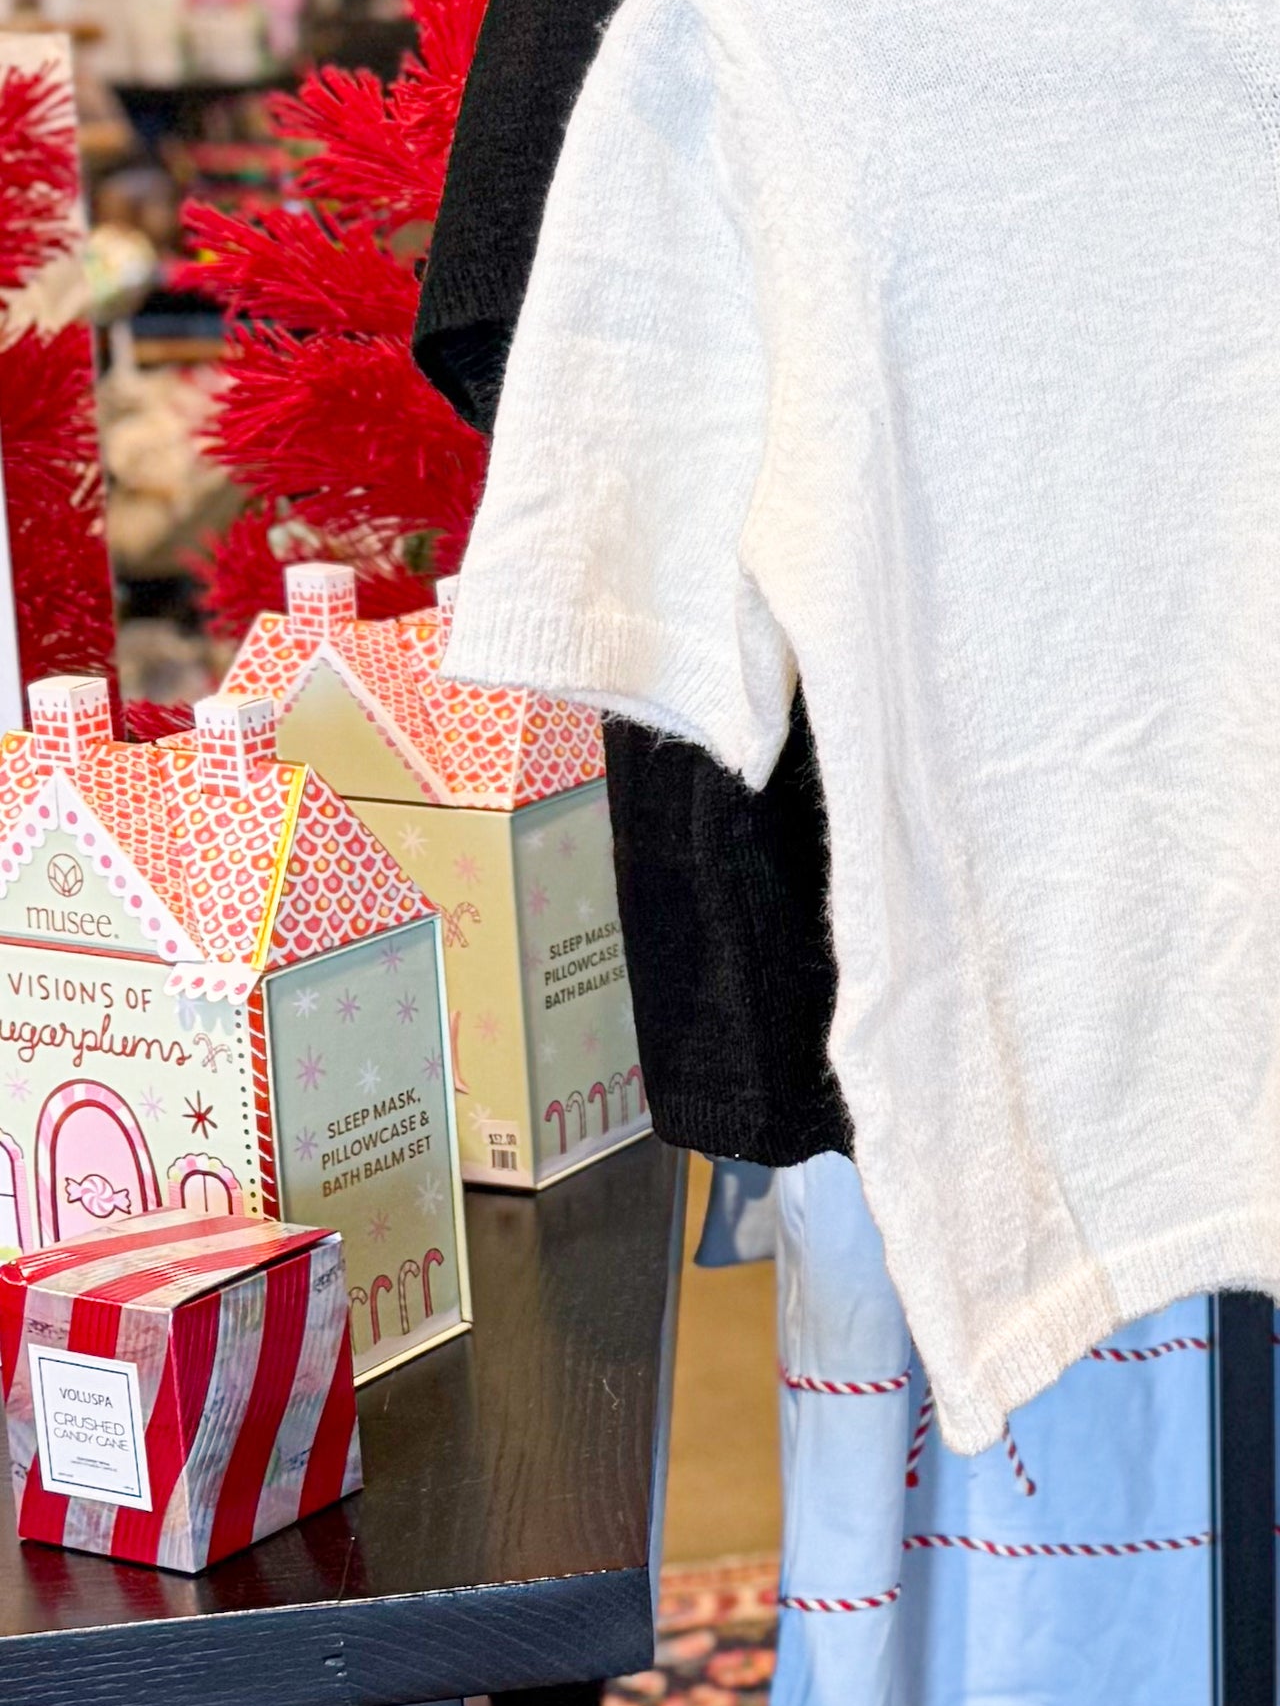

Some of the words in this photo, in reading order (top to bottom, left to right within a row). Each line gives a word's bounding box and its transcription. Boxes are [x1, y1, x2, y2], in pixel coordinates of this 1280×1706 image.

[544, 943, 619, 986] PILLOWCASE
[549, 934, 582, 960] SLEEP
[7, 972, 114, 1008] VISIONS
[125, 987, 152, 1012] OF
[545, 985, 576, 1010] BATH
[578, 971, 610, 997] BALM
[612, 964, 627, 982] SE
[0, 1013, 192, 1068] ugarplums
[321, 1114, 417, 1170] PILLOWCASE
[420, 1110, 430, 1127] &
[327, 1108, 370, 1139] SLEEP
[322, 1167, 360, 1198] BATH
[363, 1147, 405, 1179] BALM
[408, 1134, 432, 1159] SET
[59, 1387, 114, 1409] VOLUSPA
[53, 1411, 125, 1437] CRUSHED
[53, 1427, 94, 1444] CANDY
[96, 1435, 130, 1452] CANE
